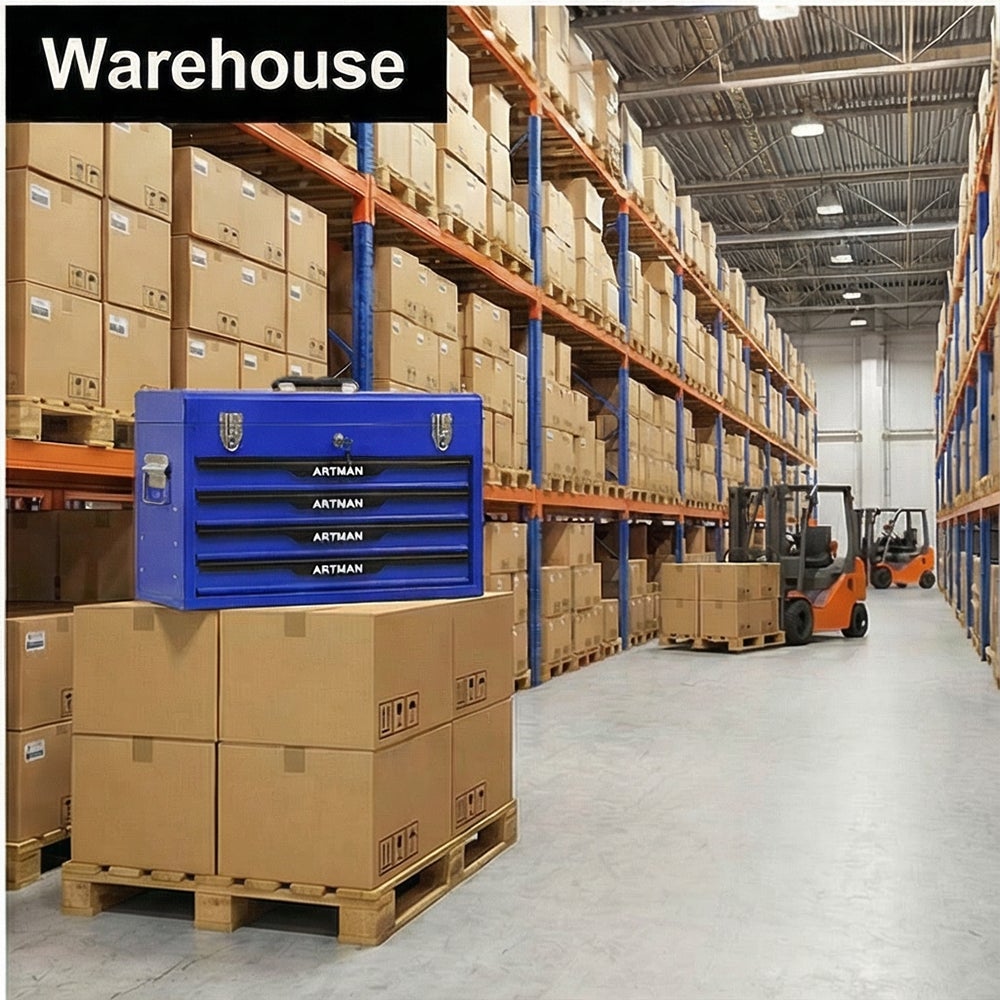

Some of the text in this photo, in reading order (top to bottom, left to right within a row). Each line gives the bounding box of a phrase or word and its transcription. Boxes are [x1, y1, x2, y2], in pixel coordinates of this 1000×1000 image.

[312, 466, 364, 477] ARTMAN
[312, 531, 364, 542] ARTMAN
[312, 563, 364, 574] ARTMAN
